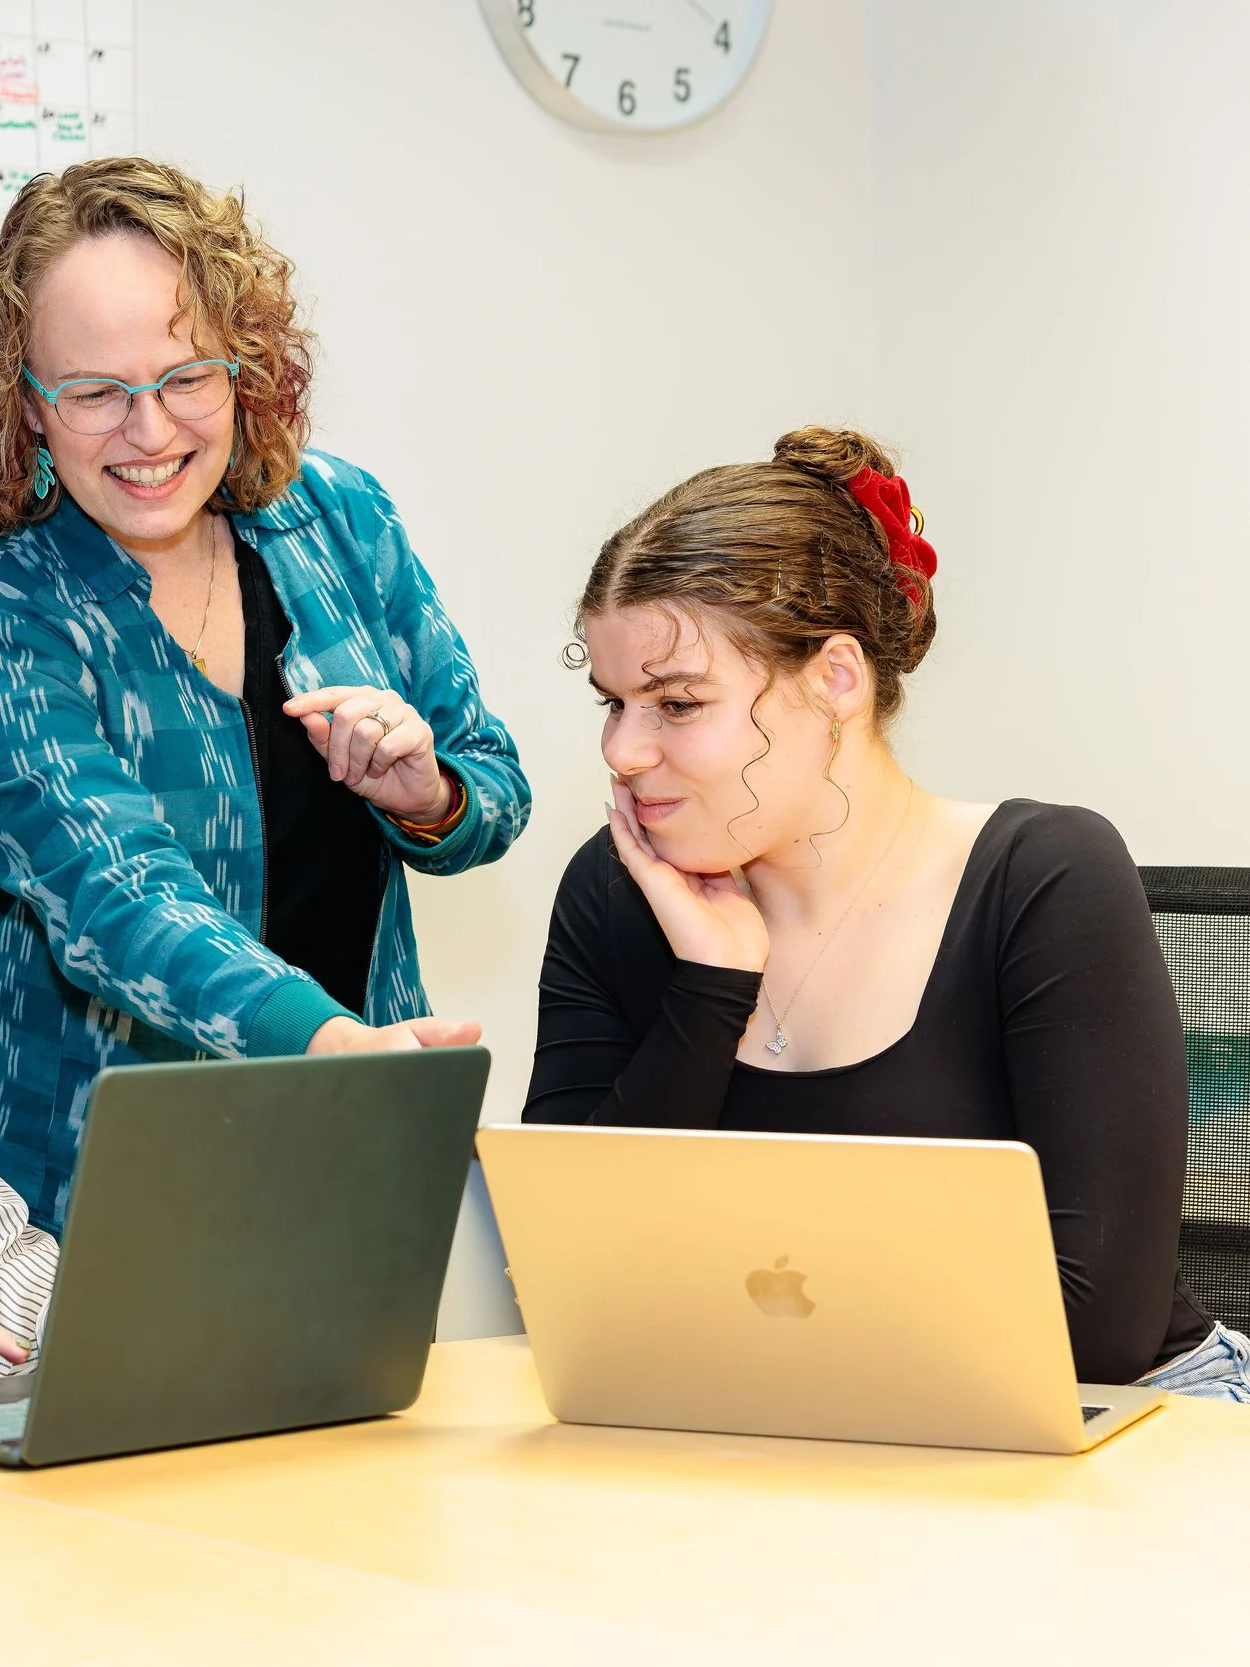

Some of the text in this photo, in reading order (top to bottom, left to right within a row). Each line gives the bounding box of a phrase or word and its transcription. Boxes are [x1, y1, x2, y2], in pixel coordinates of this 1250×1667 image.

[516, 0, 536, 28] 8
[713, 19, 732, 54] 4
[561, 52, 582, 89] 7
[673, 66, 692, 104] 5
[617, 80, 637, 117] 6
